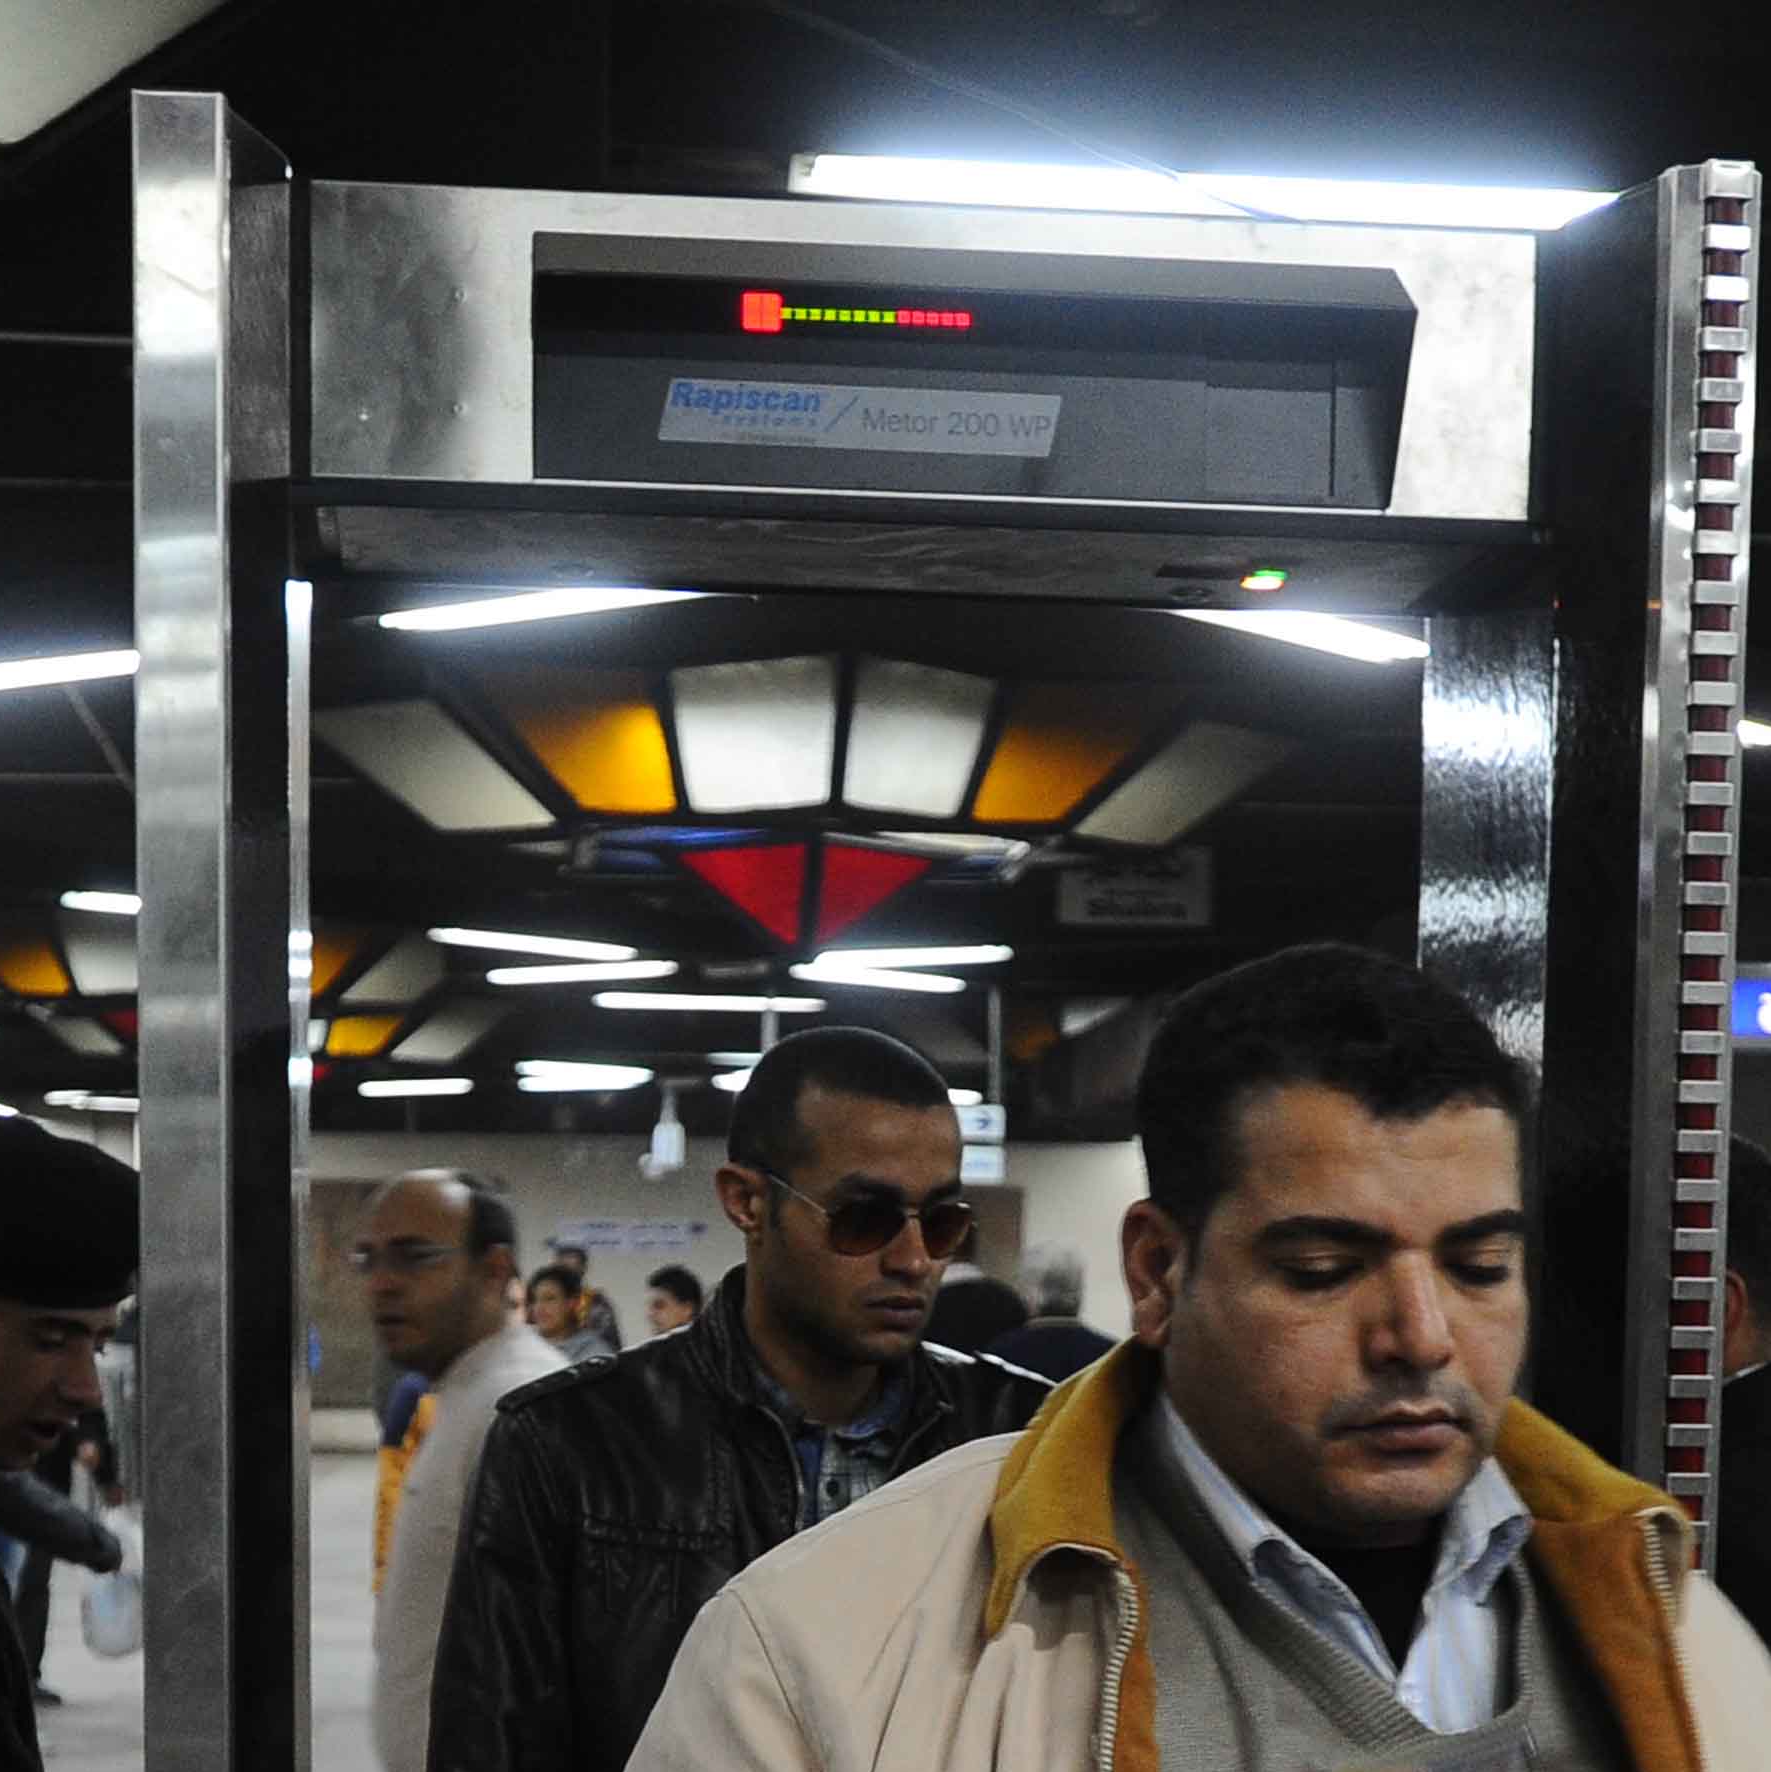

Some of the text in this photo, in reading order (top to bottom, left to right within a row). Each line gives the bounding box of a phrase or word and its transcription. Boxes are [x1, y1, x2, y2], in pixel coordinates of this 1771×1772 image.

[671, 382, 821, 415] Rapiscan
[861, 407, 1051, 438] Metor 200 WP
